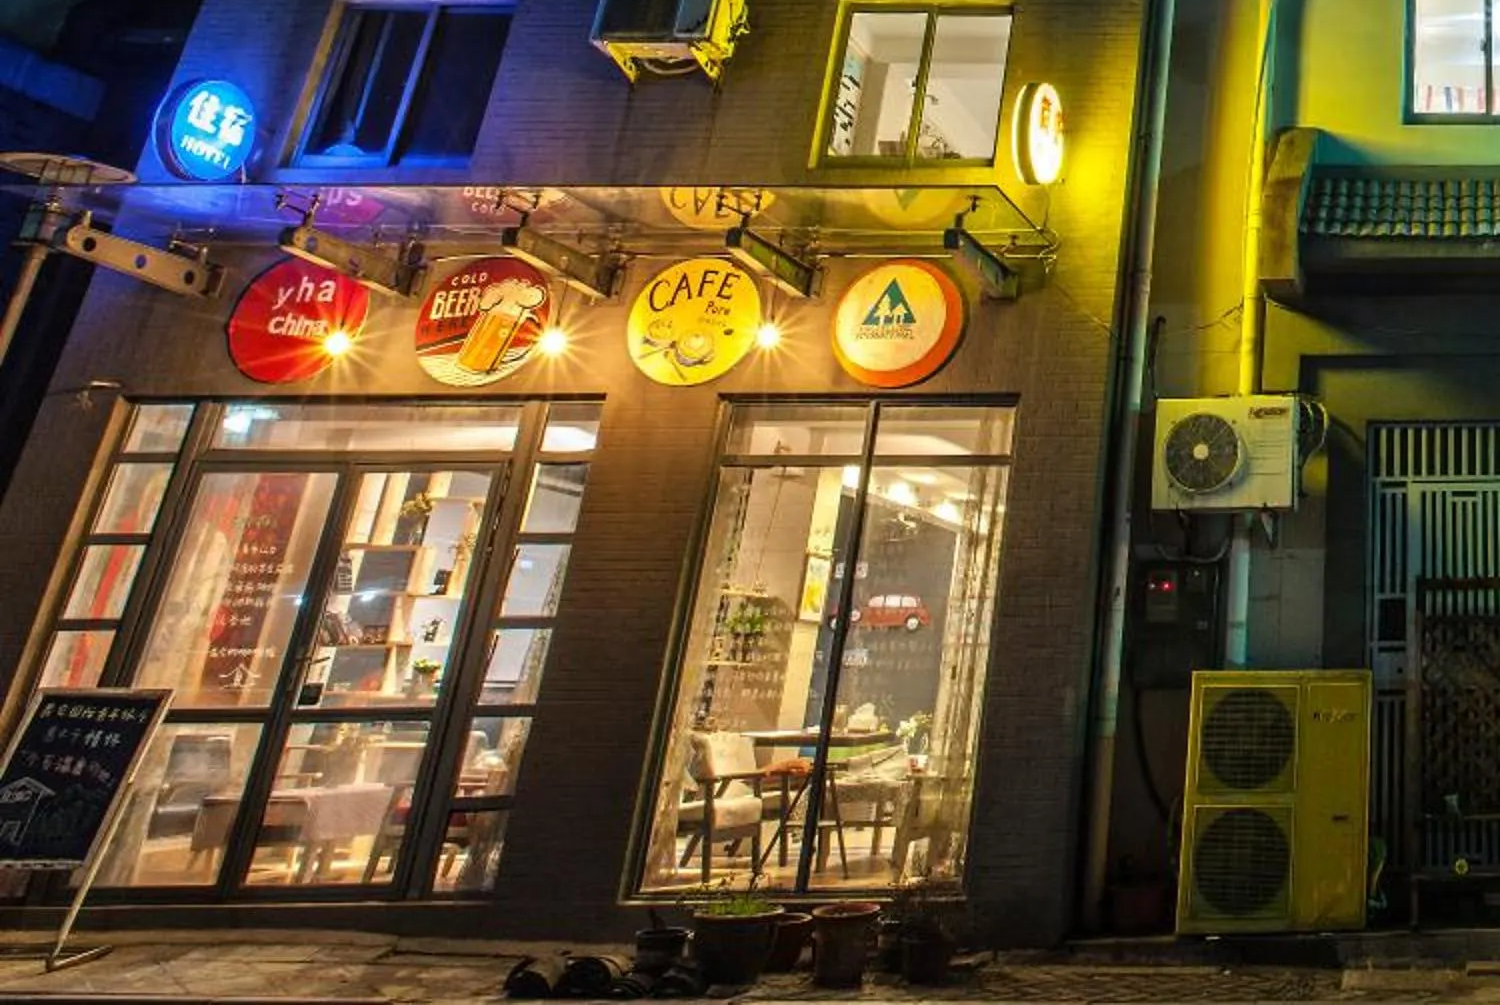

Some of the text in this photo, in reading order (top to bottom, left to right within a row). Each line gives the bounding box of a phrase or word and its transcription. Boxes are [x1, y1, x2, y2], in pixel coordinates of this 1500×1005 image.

[187, 90, 253, 147] 住宿
[180, 134, 231, 170] HOTEL
[271, 275, 337, 311] yha
[451, 272, 489, 287] COLD
[648, 269, 741, 313] CAFE
[430, 287, 482, 321] BEER
[268, 311, 329, 338] china
